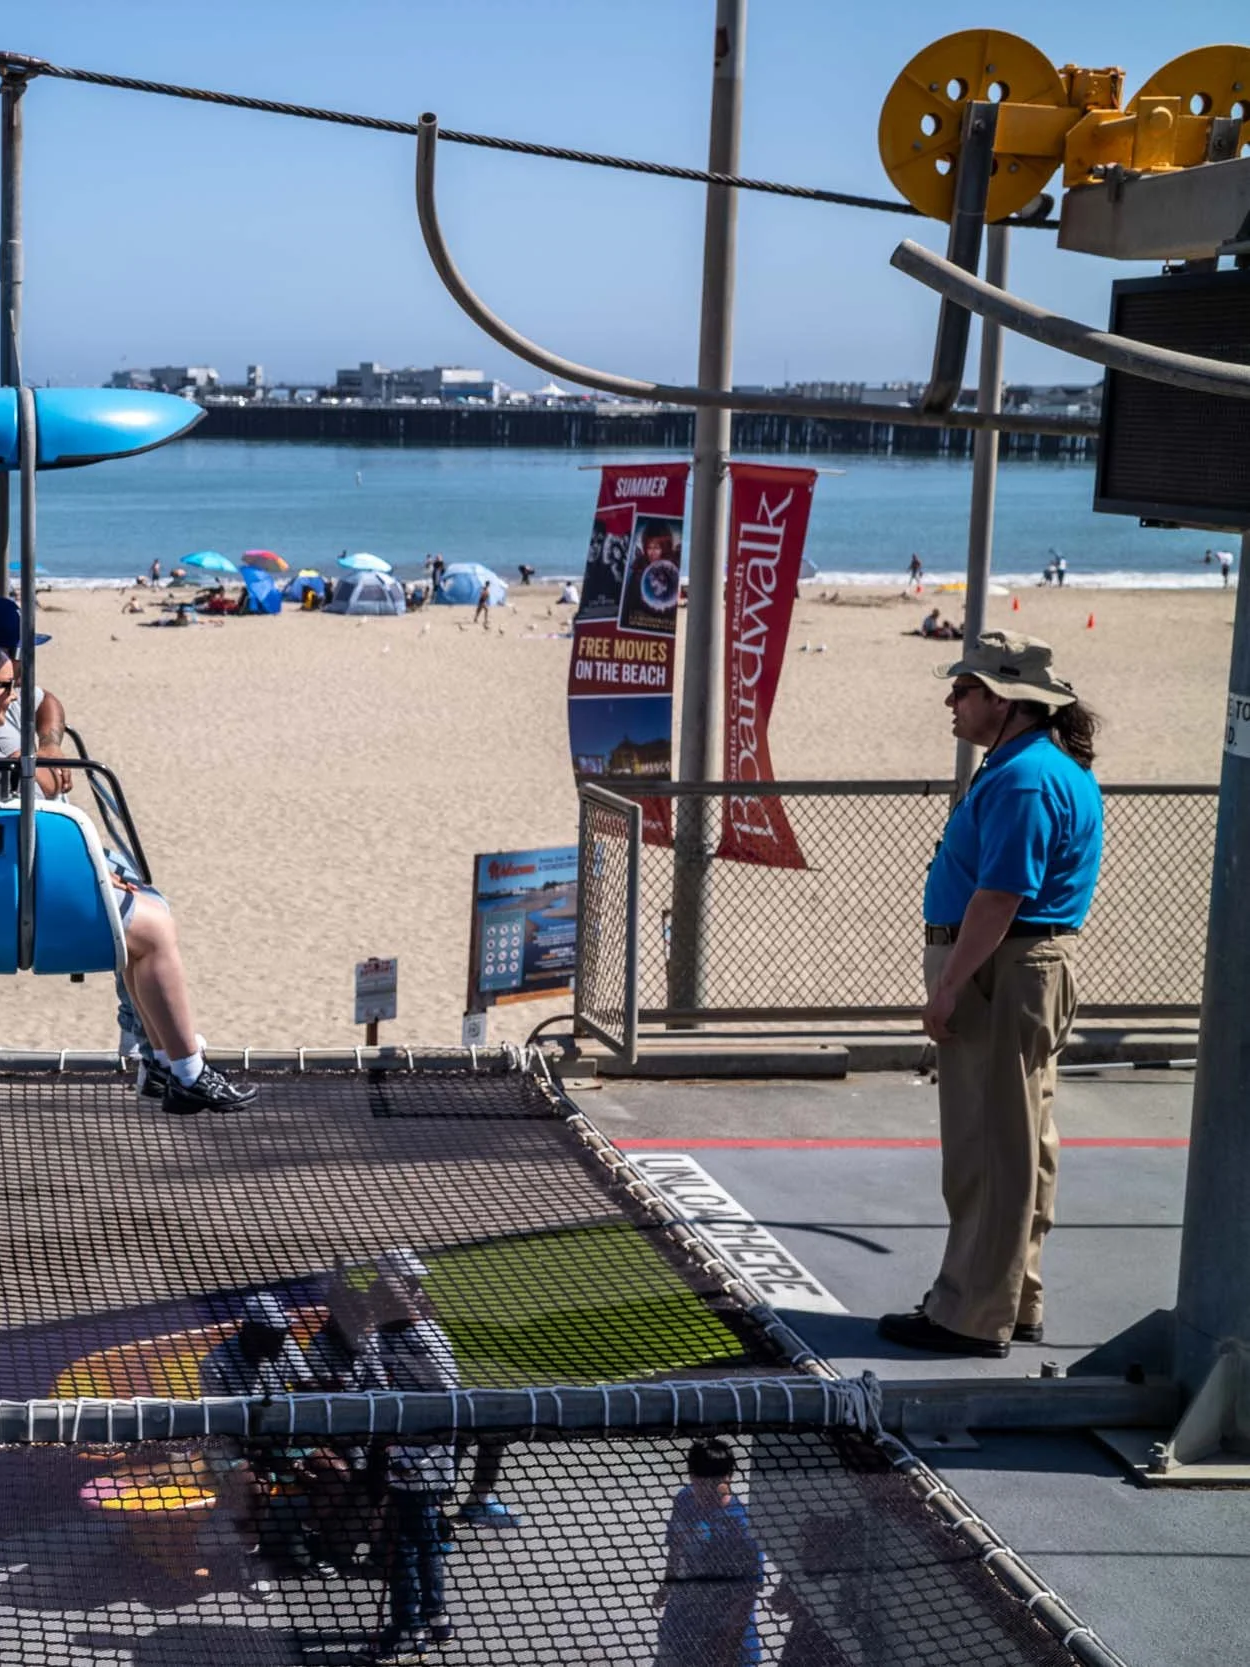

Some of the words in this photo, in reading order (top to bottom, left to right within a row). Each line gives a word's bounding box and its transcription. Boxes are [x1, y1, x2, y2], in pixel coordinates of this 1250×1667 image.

[615, 476, 668, 498] SUMMER
[732, 562, 745, 632] Beach
[575, 659, 593, 680] ON
[595, 661, 619, 682] THE
[621, 663, 667, 686] BEACH
[578, 636, 610, 659] FREE
[613, 638, 668, 662] MOVIES
[729, 488, 794, 844] Boardwalk
[636, 1158, 758, 1234] UNLOAD
[712, 1233, 823, 1297] HERE
